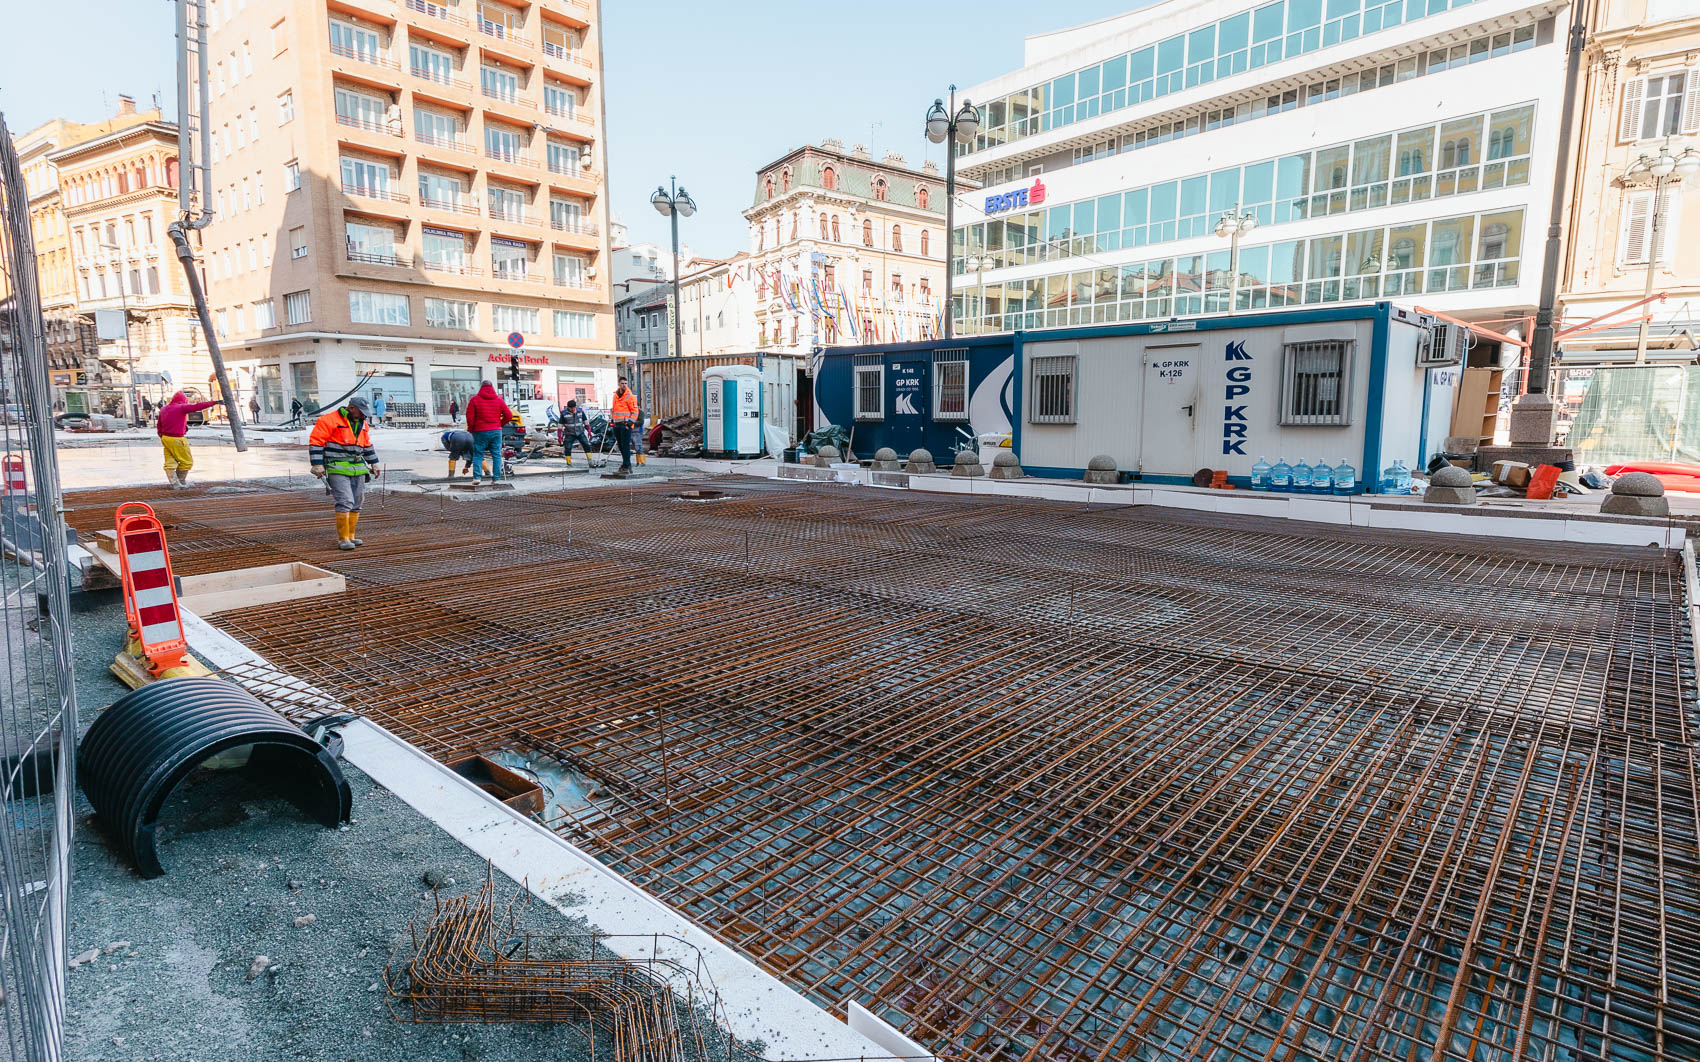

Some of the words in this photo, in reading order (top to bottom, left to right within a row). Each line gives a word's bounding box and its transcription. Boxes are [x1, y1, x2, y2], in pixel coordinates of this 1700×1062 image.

[985, 187, 1029, 214] ERSTE
[488, 353, 523, 363] Addio
[525, 354, 549, 365] Bank
[1160, 369, 1183, 378] K-126
[895, 379, 905, 387] GP
[905, 378, 920, 386] KRK
